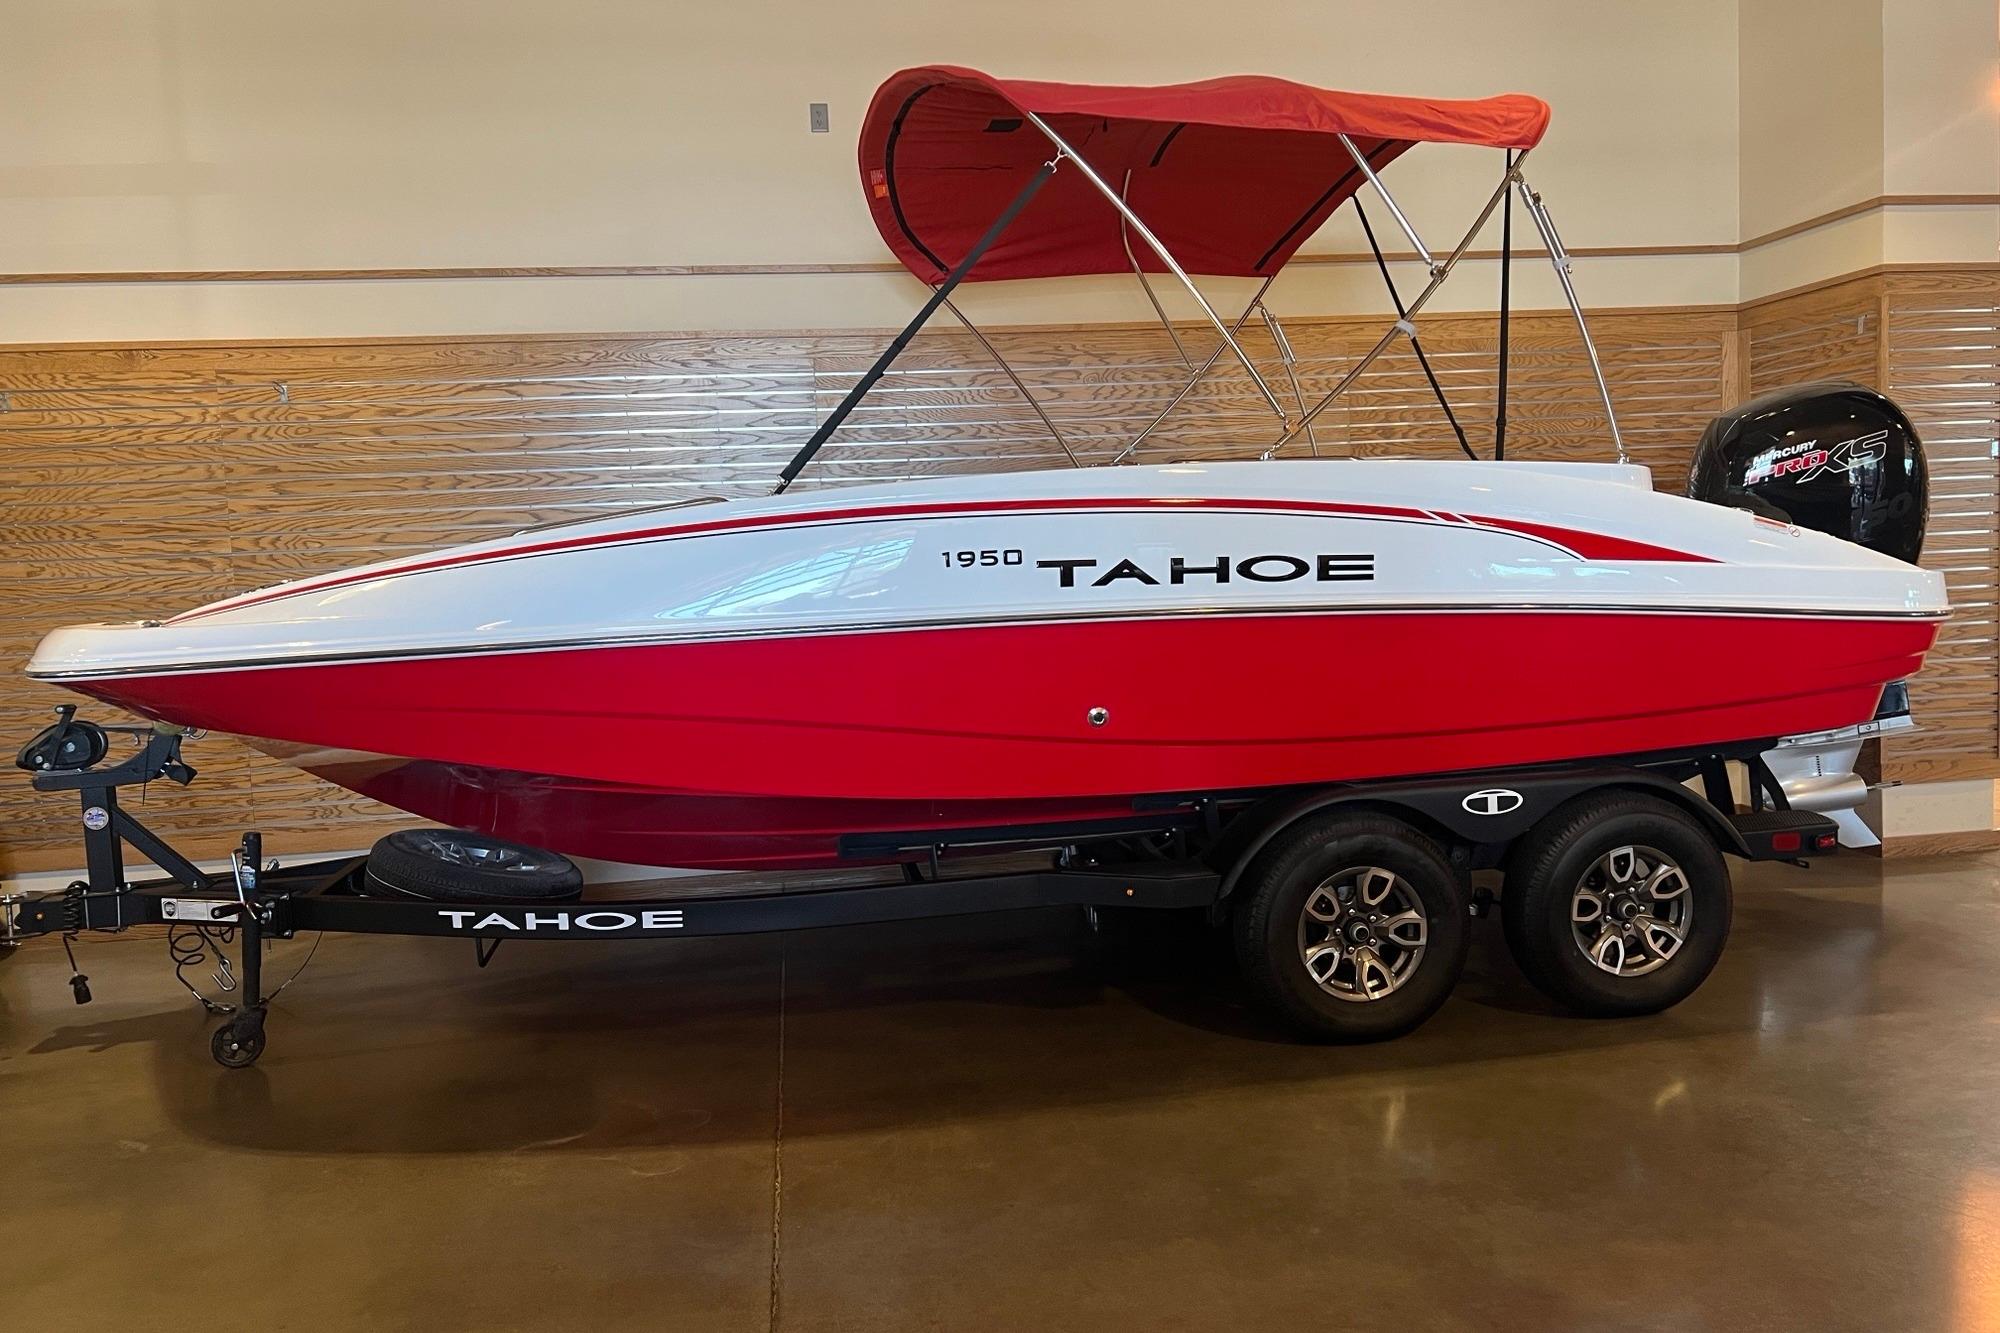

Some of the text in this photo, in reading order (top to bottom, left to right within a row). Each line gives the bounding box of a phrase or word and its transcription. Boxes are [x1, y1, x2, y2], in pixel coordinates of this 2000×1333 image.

[1753, 439, 1817, 467] MERCURY
[942, 550, 1375, 587] 1950 TAHOE
[438, 910, 684, 931] TAHOE
